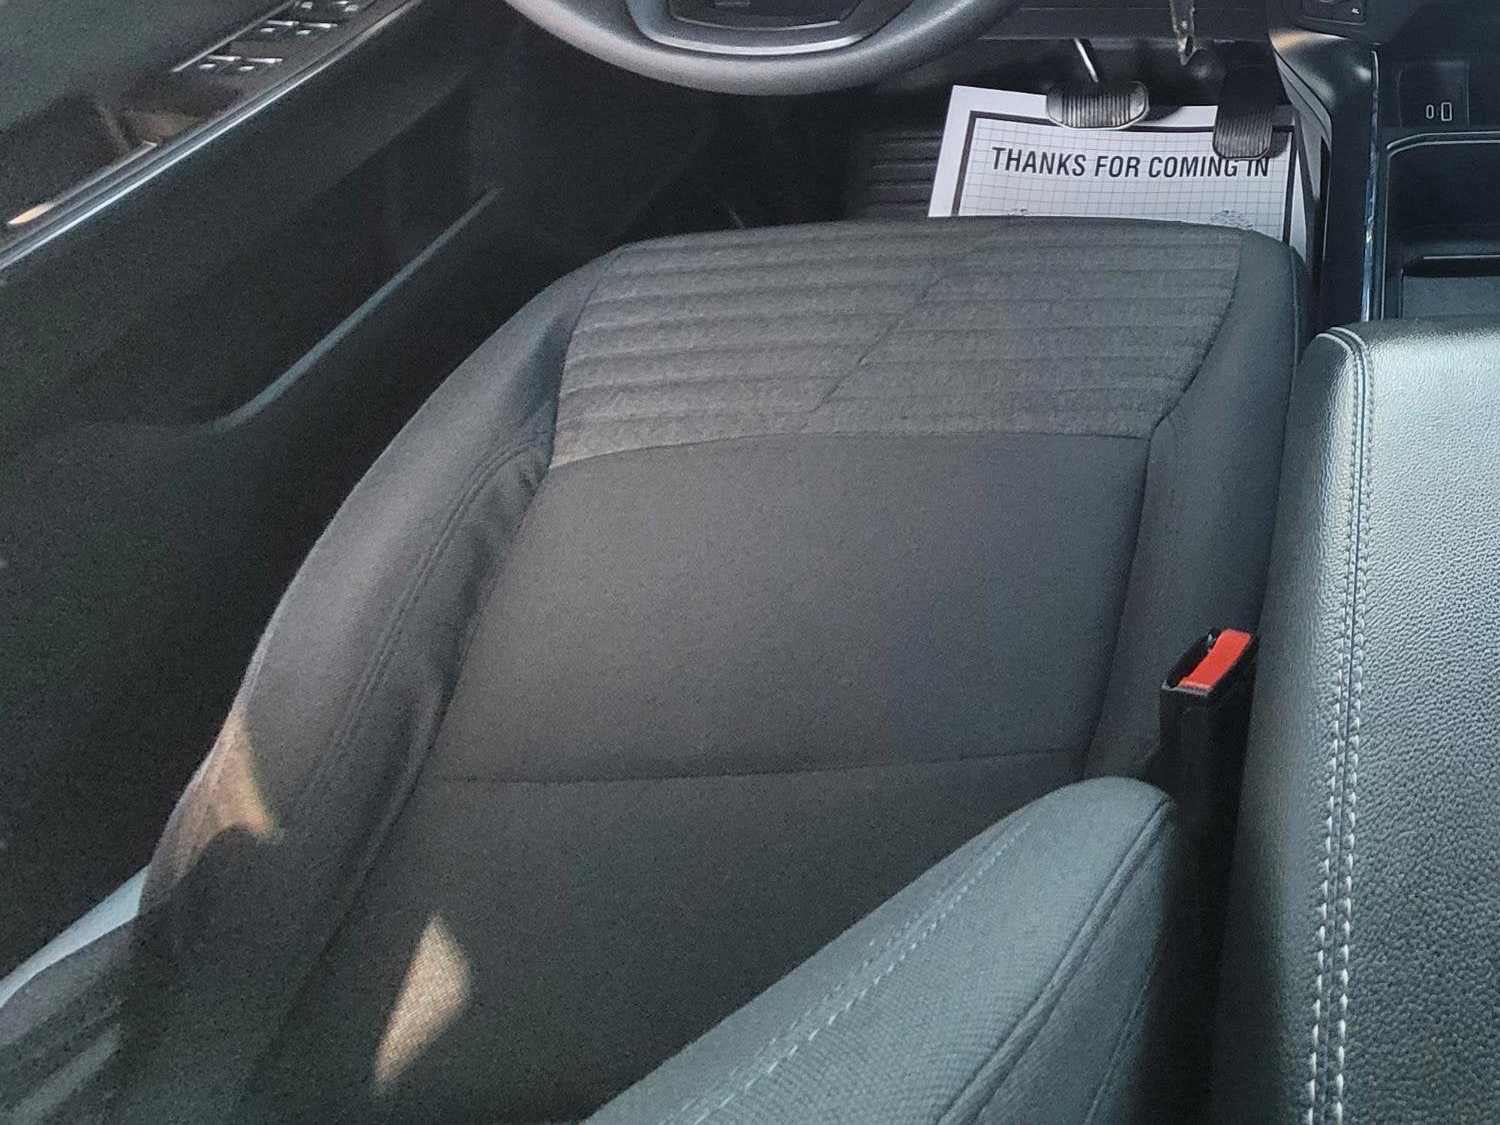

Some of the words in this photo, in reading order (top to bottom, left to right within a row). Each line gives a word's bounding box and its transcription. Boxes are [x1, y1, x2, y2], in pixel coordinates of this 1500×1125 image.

[991, 146, 1087, 177] THANKS
[1093, 155, 1140, 178] FOR
[1149, 156, 1238, 178] COMING
[1246, 157, 1269, 178] IN
